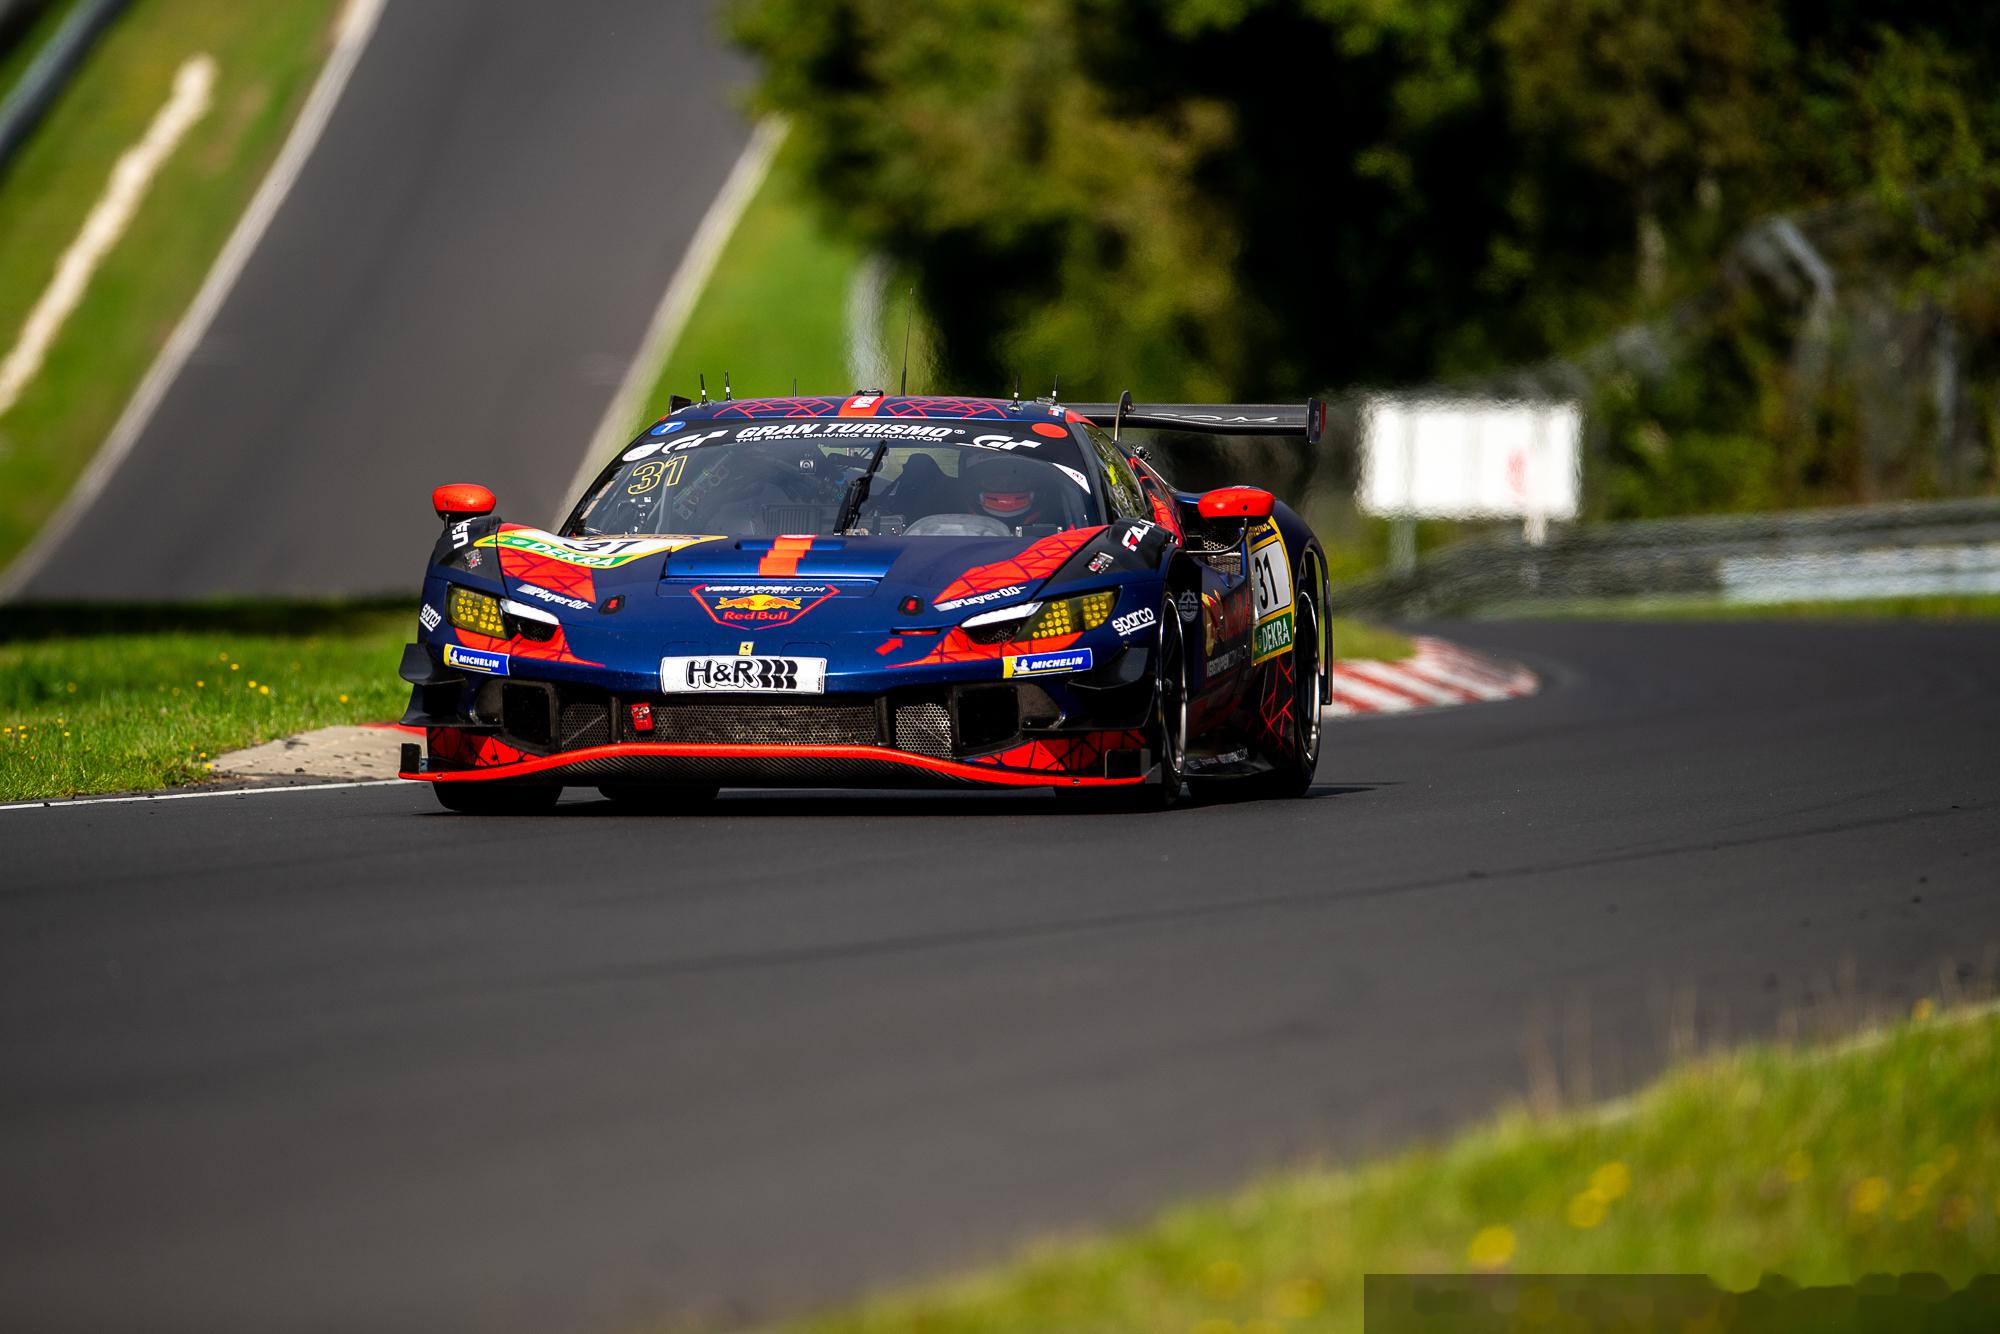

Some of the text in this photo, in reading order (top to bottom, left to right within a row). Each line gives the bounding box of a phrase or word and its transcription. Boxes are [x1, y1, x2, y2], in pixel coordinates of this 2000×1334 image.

[736, 423, 953, 439] GRAN TURISMO
[862, 433, 943, 442] SIMULATOR
[627, 455, 688, 495] 31
[526, 542, 616, 567] DEKRA
[1255, 551, 1279, 610] 31
[723, 610, 790, 621] Red Bull
[1111, 607, 1155, 635] sparco
[1261, 617, 1291, 653] DEKRA
[459, 654, 500, 669] MICHELIN
[686, 659, 759, 687] H&R
[1030, 656, 1084, 670] MICHELIN
